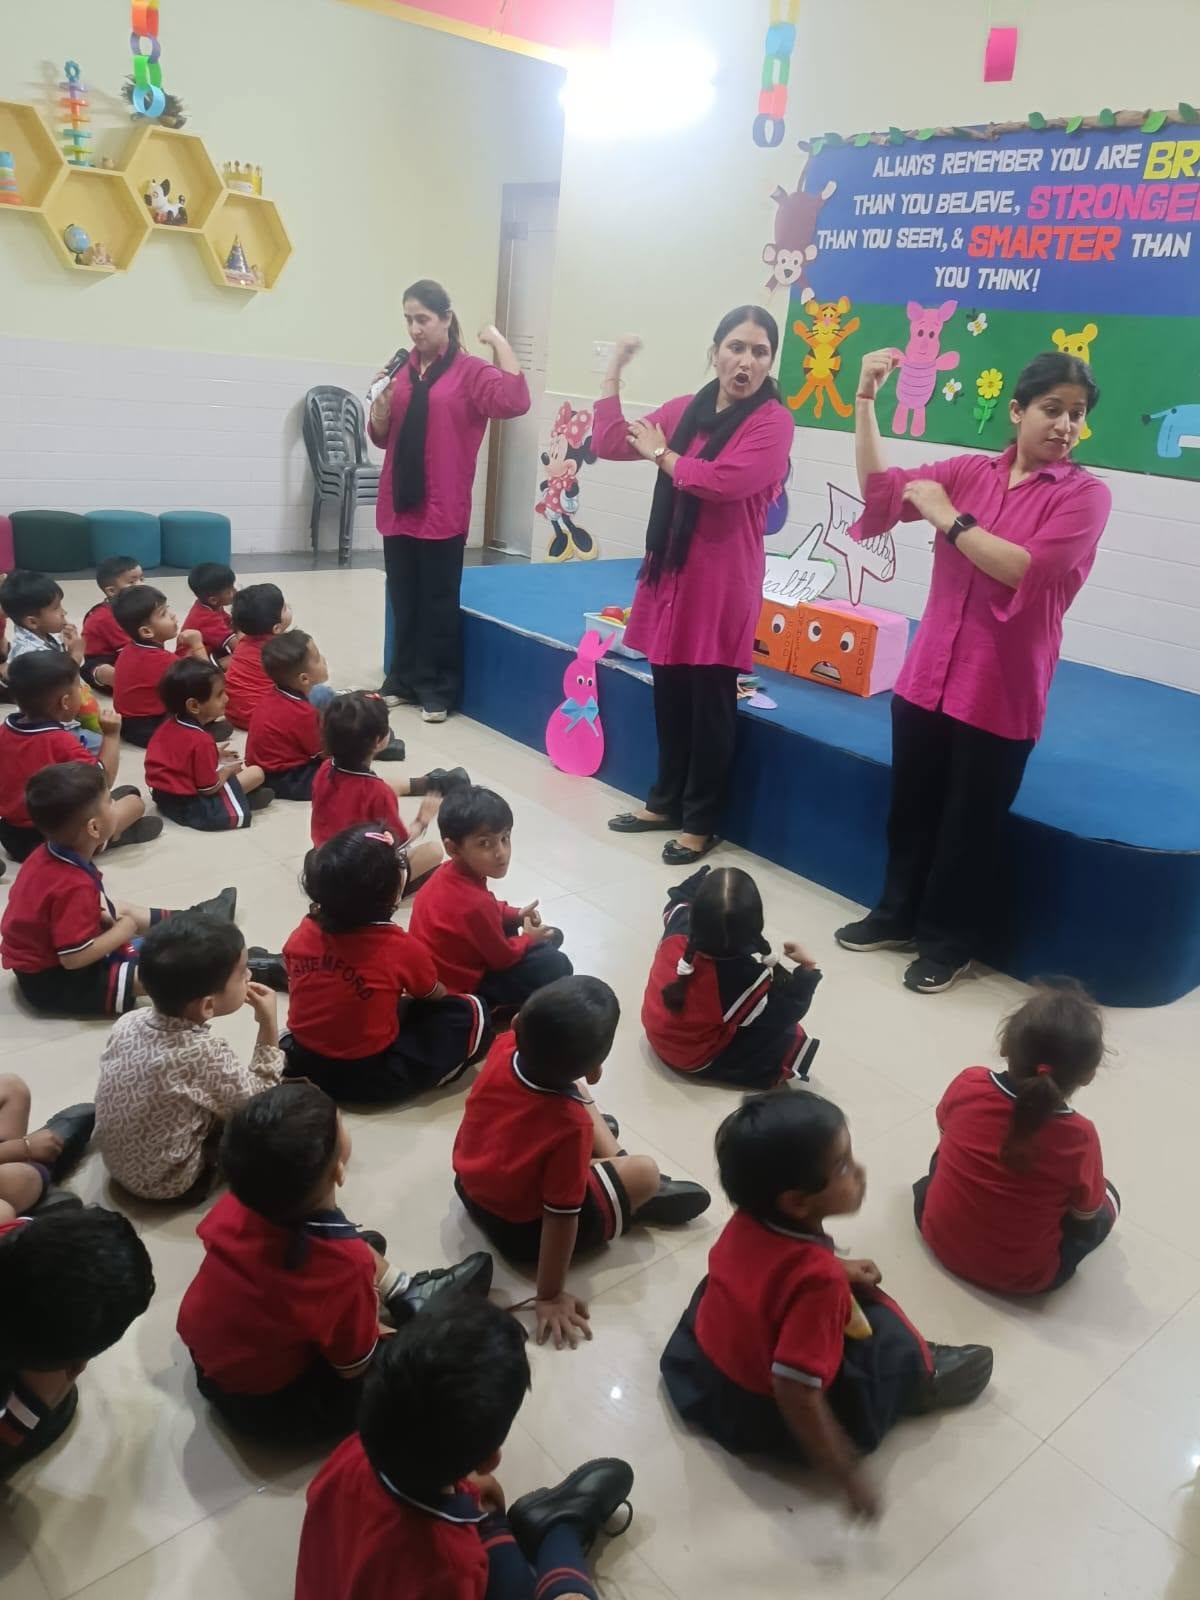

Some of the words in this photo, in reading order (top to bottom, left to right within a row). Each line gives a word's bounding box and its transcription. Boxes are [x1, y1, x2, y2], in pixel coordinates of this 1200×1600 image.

[873, 152, 935, 177] ALWAYS
[941, 148, 1044, 174] REMEMBER
[1050, 146, 1091, 172] YOU
[1095, 143, 1143, 170] ARE
[1143, 140, 1200, 181] BR
[853, 193, 896, 216] THAN
[900, 191, 935, 215] YOU
[935, 190, 1021, 216] BELIEVE,
[817, 228, 857, 250] THAN
[862, 227, 893, 250] YOU
[967, 224, 1122, 262] SMARTER
[1131, 232, 1192, 259] THAN
[934, 265, 970, 289] YOU
[978, 267, 1041, 293] THINK!
